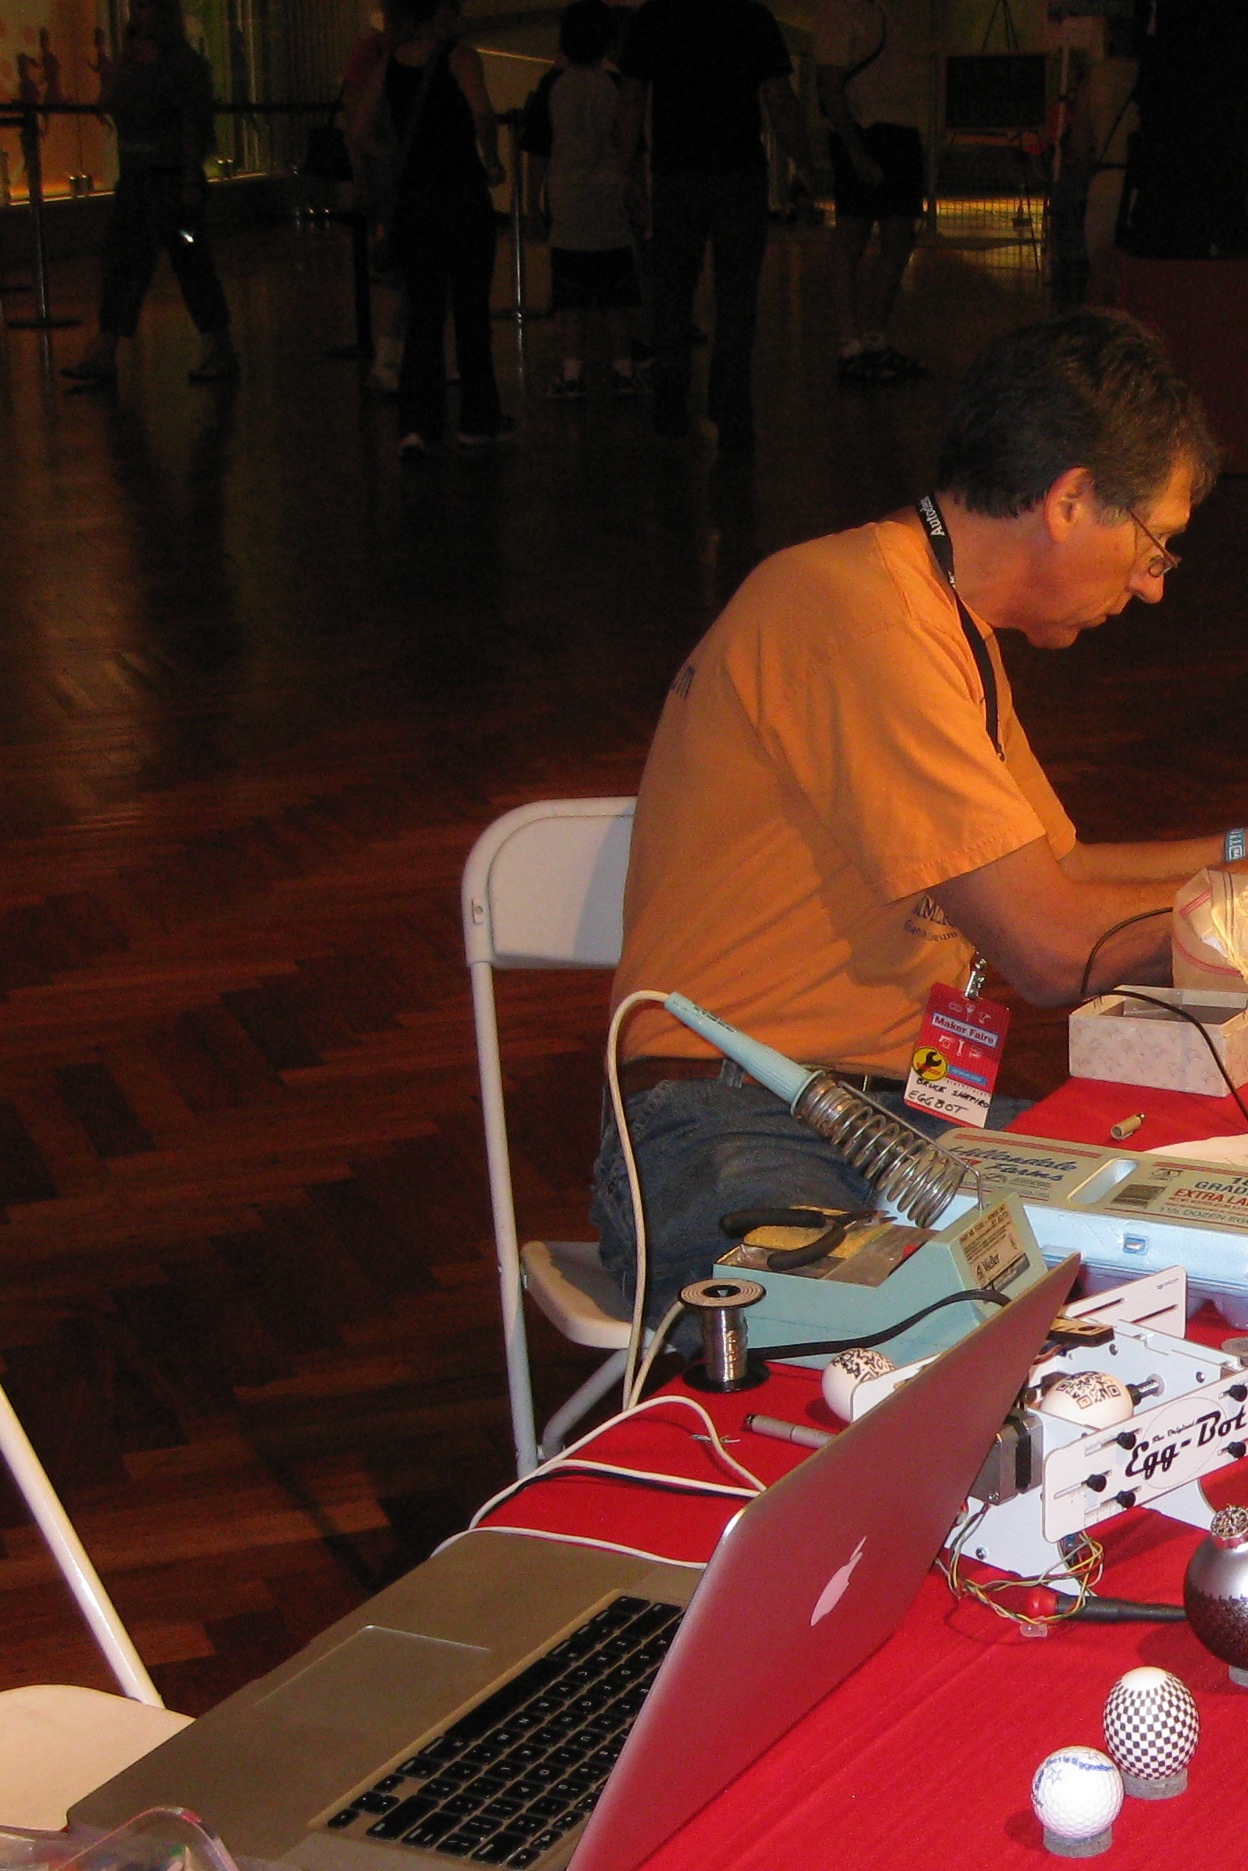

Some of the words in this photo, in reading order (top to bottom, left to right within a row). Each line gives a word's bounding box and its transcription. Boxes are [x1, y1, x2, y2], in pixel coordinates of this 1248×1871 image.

[934, 1014, 967, 1035] Maker
[969, 1028, 996, 1045] Faire
[1174, 1188, 1224, 1203] EXTRA
[1125, 1404, 1248, 1480] Egg-Bot
